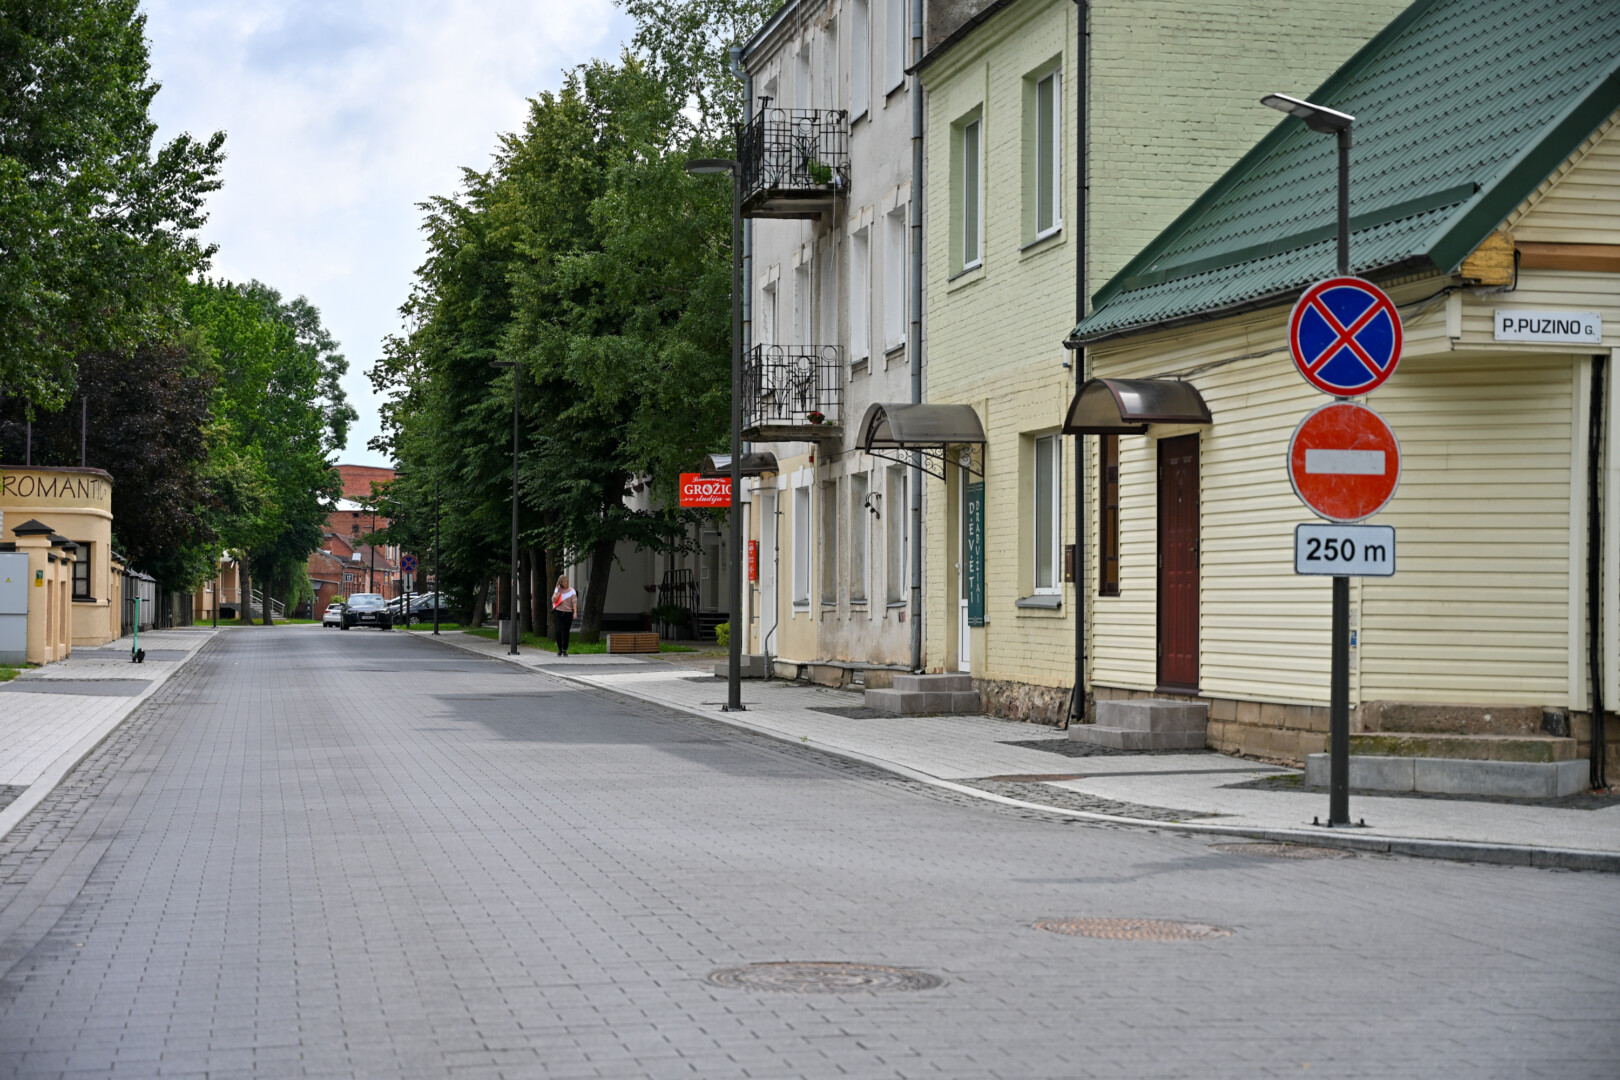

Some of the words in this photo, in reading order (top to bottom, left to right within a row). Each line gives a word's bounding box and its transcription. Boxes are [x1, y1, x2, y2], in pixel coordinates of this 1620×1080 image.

[1503, 318, 1581, 334] P.PUZINO
[1584, 325, 1595, 335] G.
[1306, 538, 1355, 562] 250
[1364, 545, 1386, 562] m
